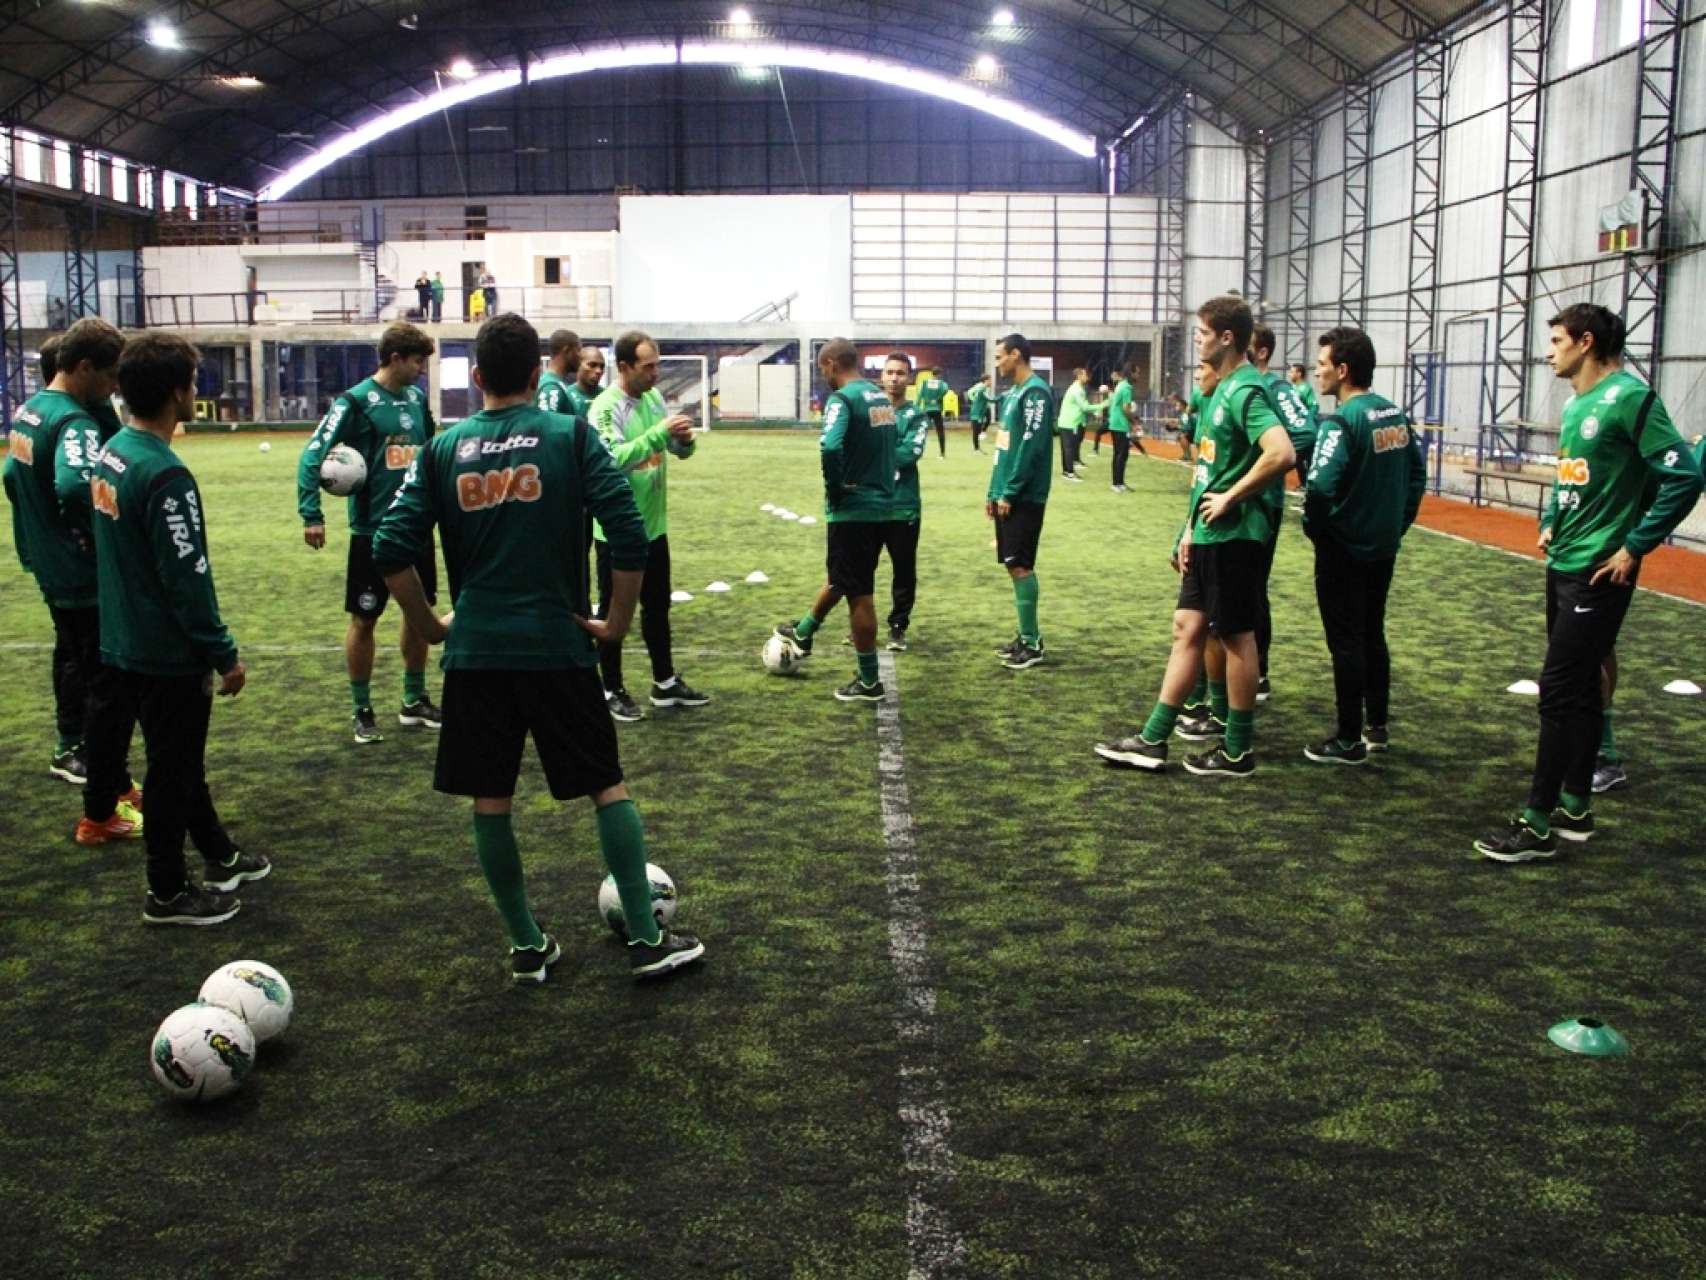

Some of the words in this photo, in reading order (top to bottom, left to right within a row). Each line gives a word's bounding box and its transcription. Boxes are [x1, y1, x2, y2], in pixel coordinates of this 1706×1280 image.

[481, 435, 539, 454] lotto
[1372, 424, 1410, 455] BMG
[456, 463, 542, 513] BMG
[165, 513, 195, 559] IRA
